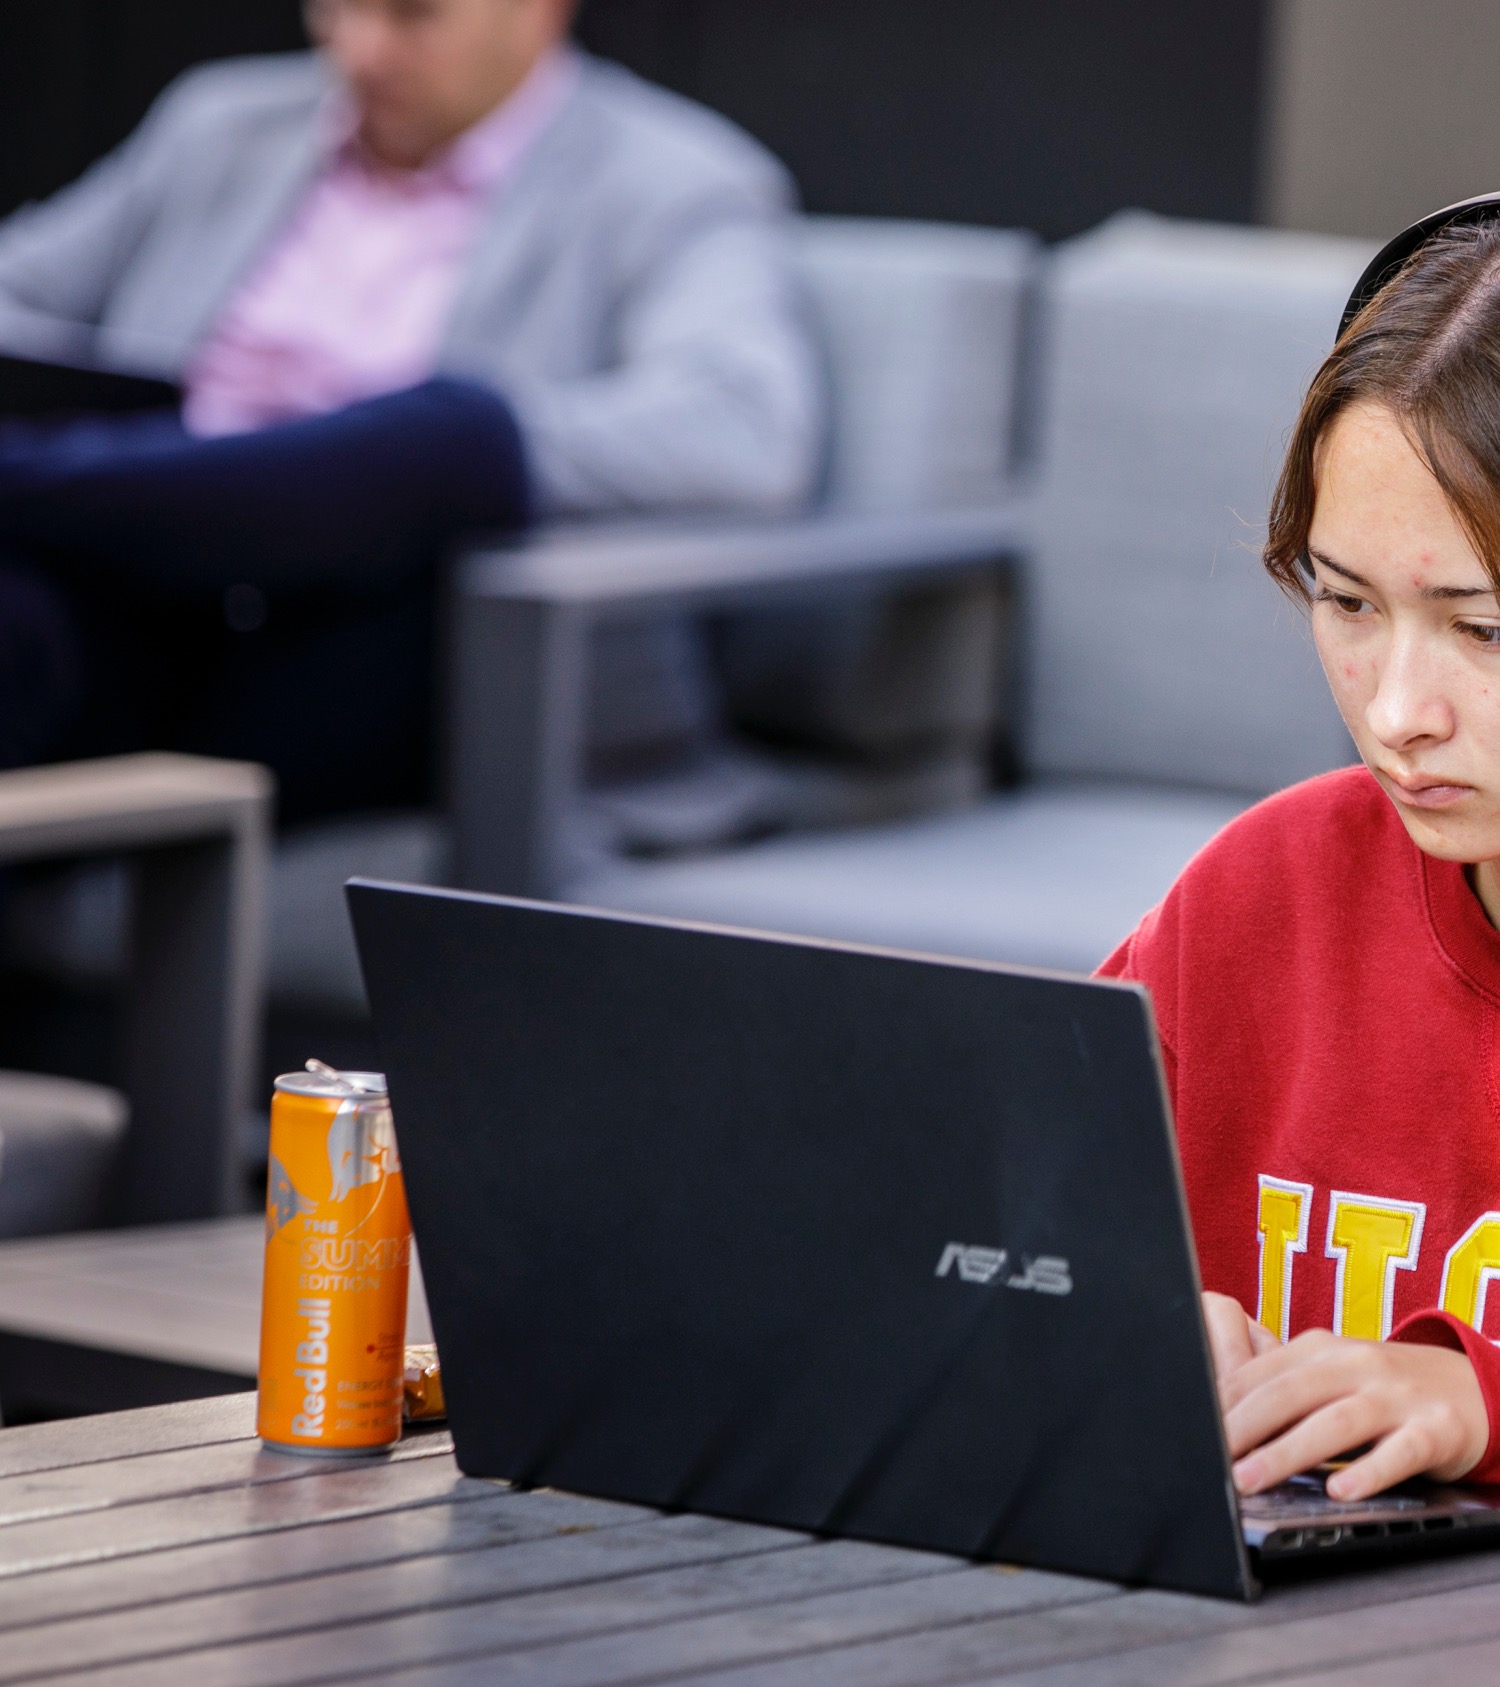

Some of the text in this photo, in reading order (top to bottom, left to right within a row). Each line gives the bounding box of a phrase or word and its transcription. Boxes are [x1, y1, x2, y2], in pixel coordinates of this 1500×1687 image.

[303, 1218, 338, 1234] THE
[298, 1272, 381, 1291] EDITION
[935, 1241, 1073, 1296] ASUS
[291, 1298, 331, 1437] Red Bull
